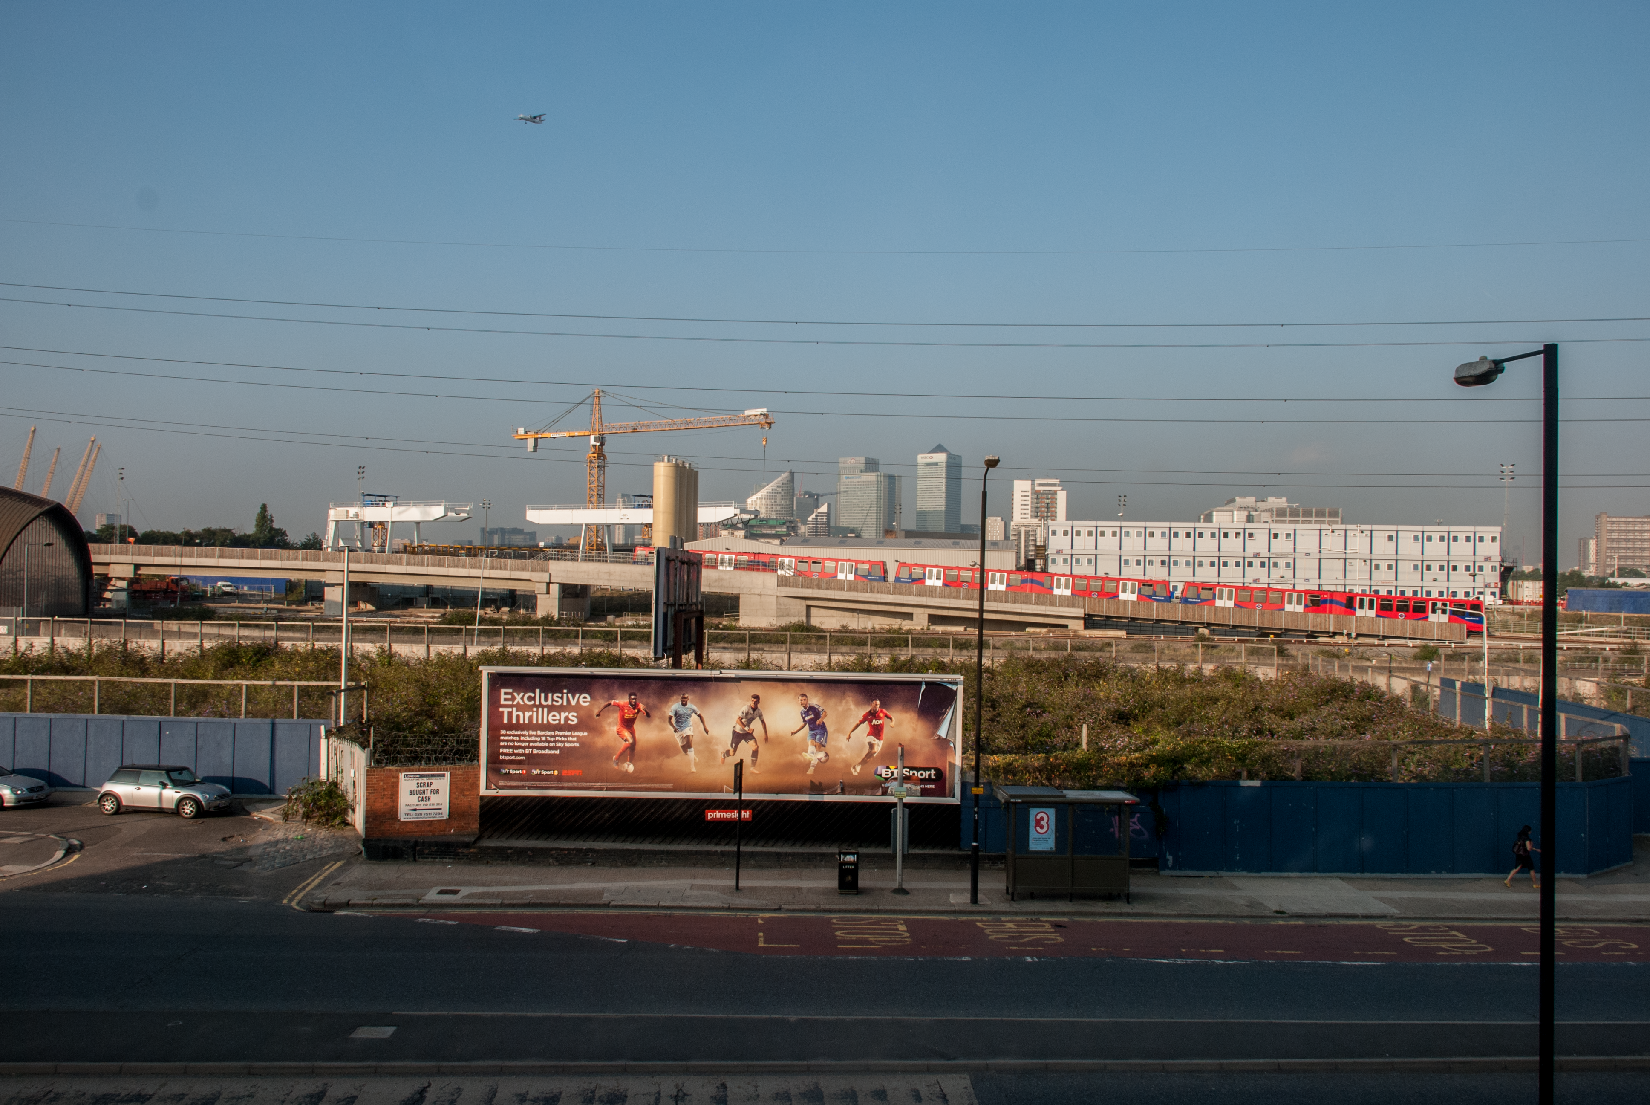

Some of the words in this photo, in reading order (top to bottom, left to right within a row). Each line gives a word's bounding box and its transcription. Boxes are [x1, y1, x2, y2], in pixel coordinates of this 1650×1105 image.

[500, 689, 591, 706] Exclusive
[499, 708, 578, 724] Thrillers
[881, 768, 899, 778] BT
[1035, 811, 1049, 834] 3
[831, 918, 913, 946] STOP
[976, 922, 1065, 944] BUS
[1375, 924, 1494, 952] STOP
